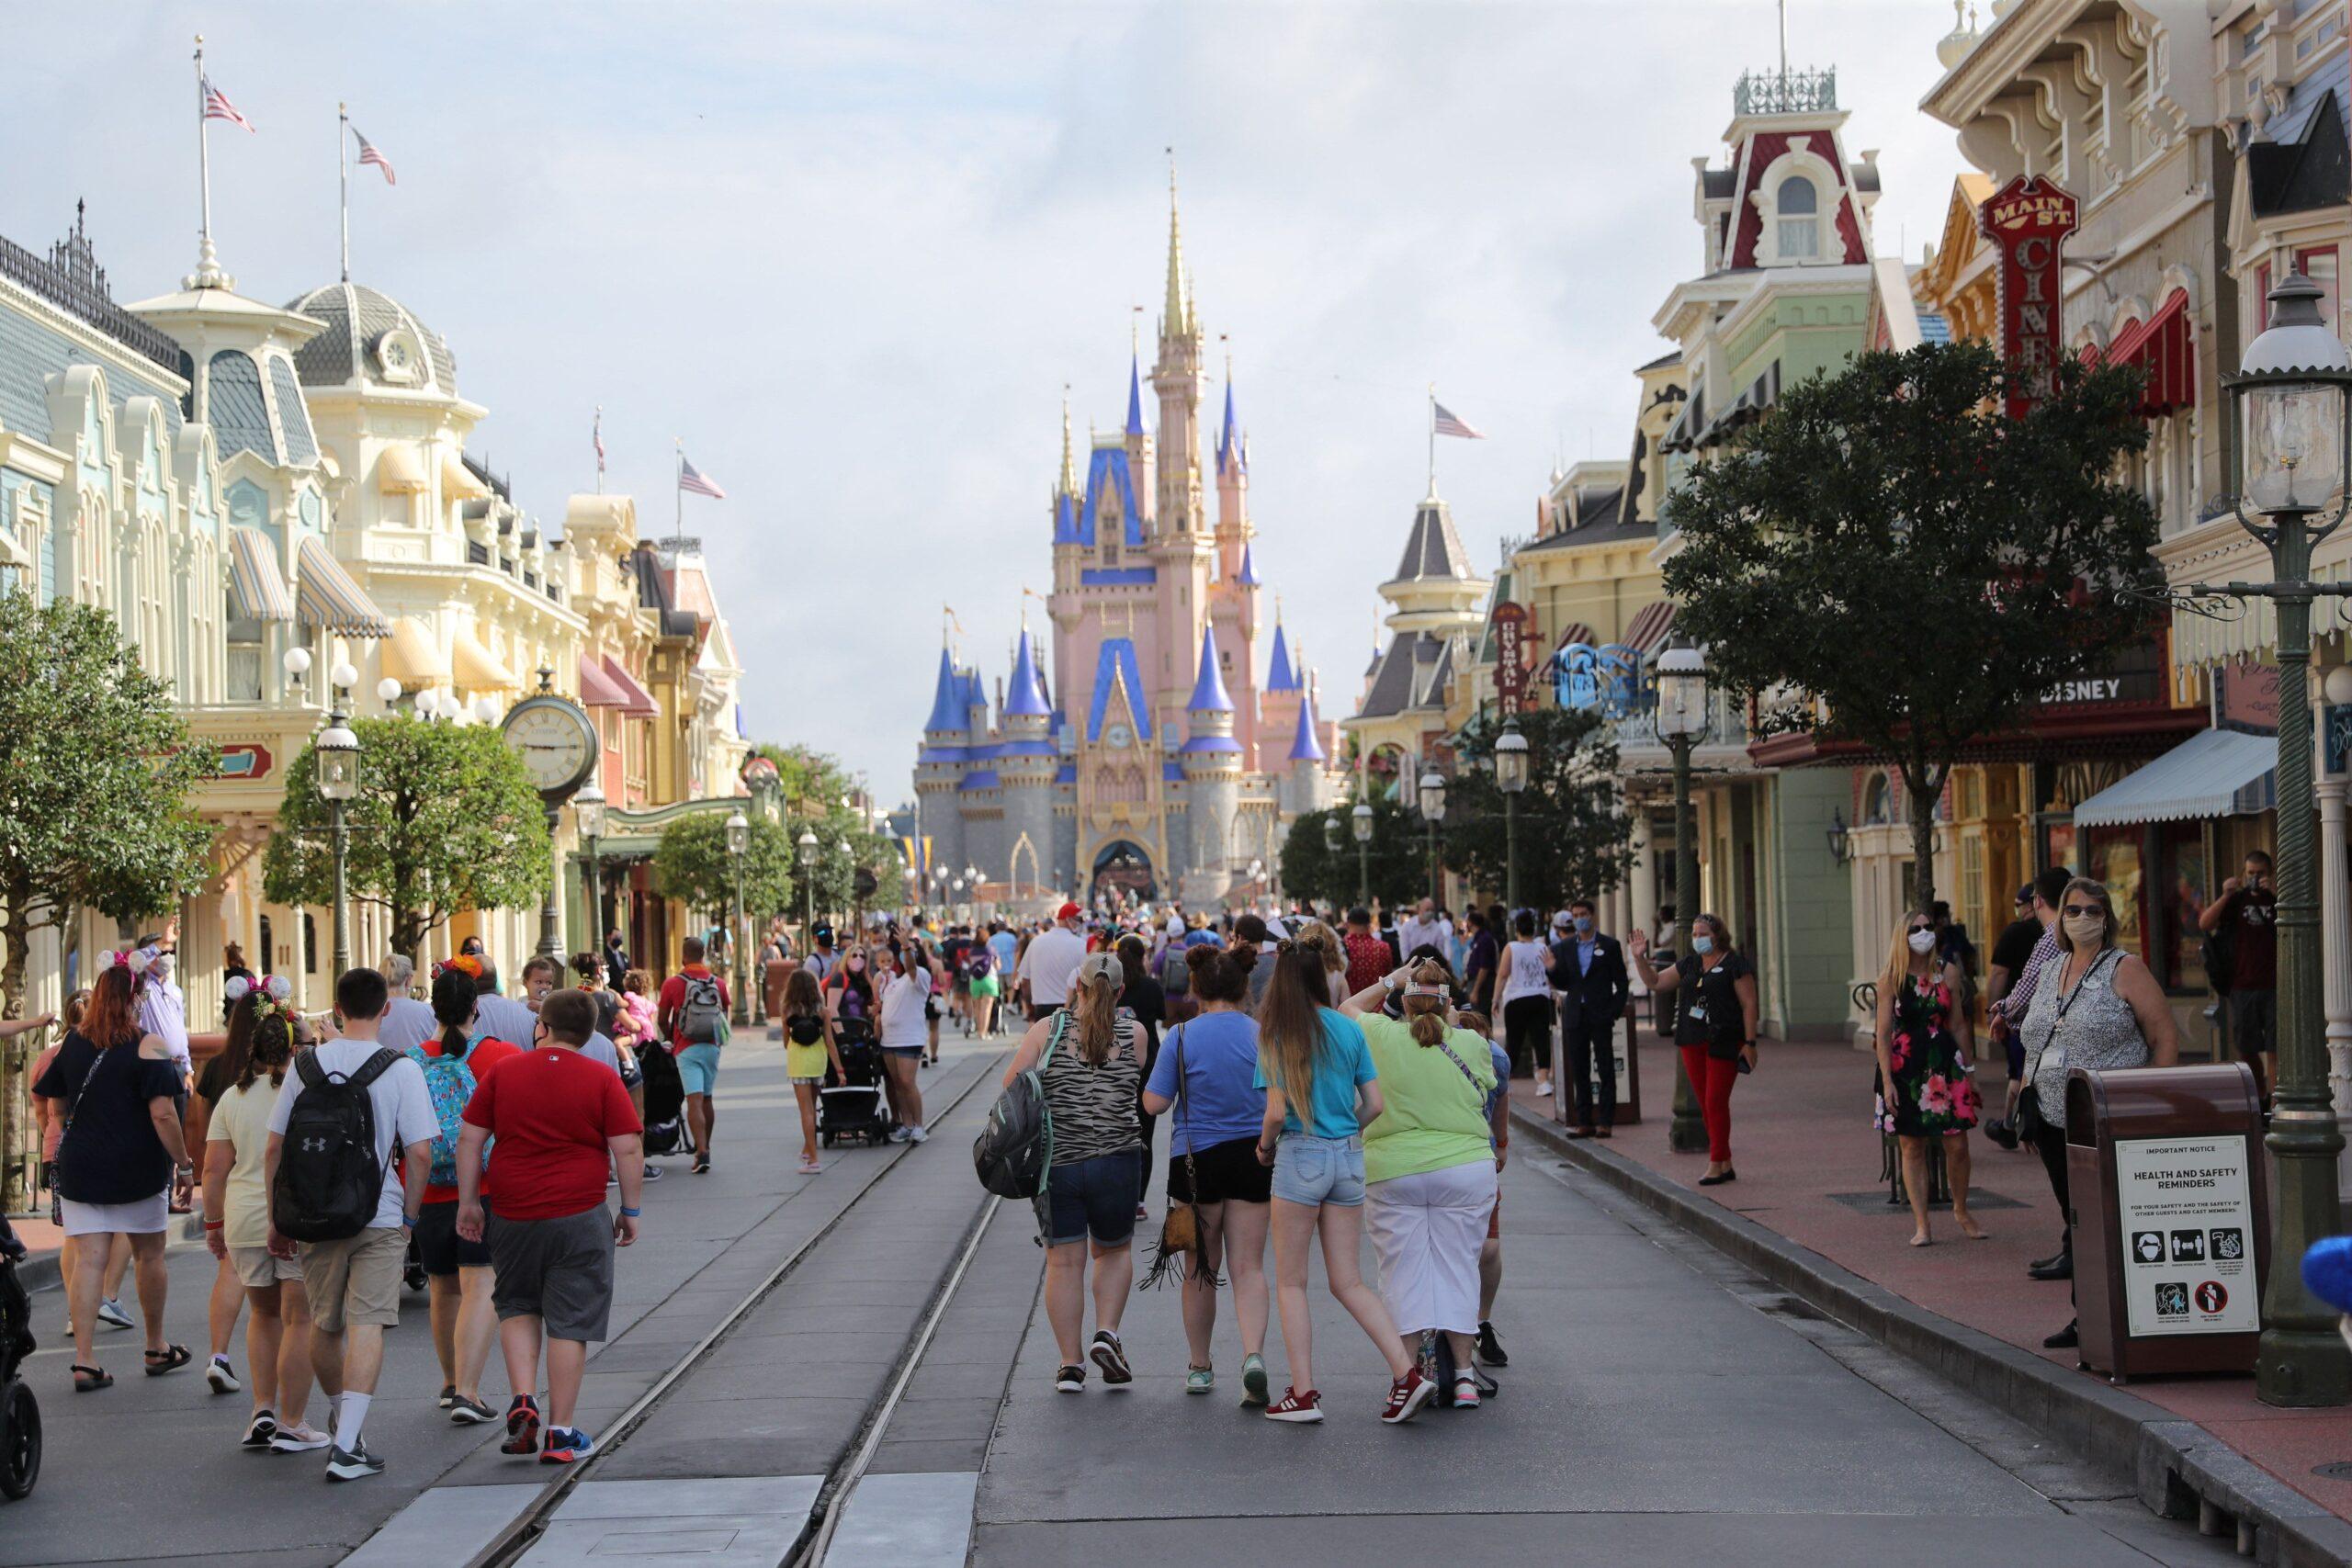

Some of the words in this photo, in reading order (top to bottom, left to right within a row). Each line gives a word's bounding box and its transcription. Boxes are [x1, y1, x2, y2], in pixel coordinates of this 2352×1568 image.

[1992, 196, 2065, 225] MAIN
[2037, 210, 2073, 226] ST.
[2015, 237, 2055, 410] CINEM
[2146, 1146, 2188, 1155] IMPORTANT
[2133, 1170, 2174, 1180] HEALTH
[2176, 1169, 2198, 1179] AND
[2199, 1168, 2238, 1178] SAFETY
[2158, 1179, 2216, 1190] REMINDERS
